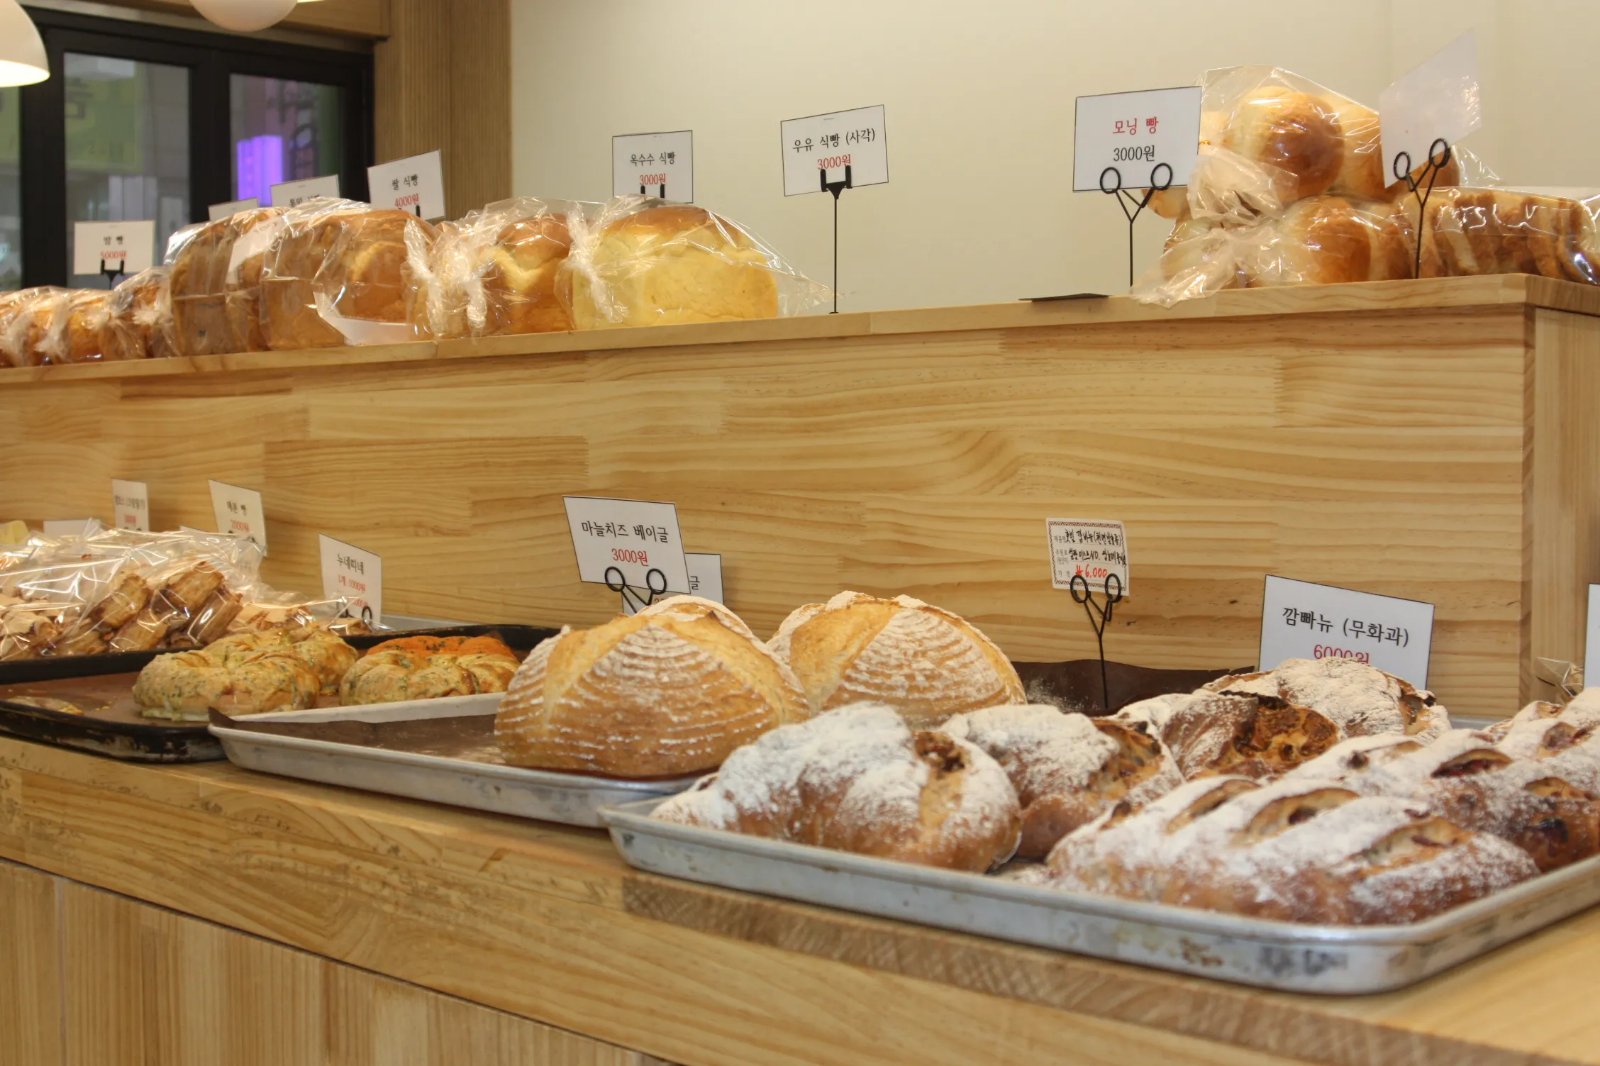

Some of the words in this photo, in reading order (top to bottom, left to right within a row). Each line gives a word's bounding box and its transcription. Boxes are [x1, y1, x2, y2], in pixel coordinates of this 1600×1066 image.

[1113, 117, 1137, 136] 모닝
[1145, 116, 1159, 135] 빵
[793, 138, 814, 153] 우유
[820, 133, 840, 149] 식빵
[845, 128, 876, 146] (사각)
[630, 153, 655, 167] 옥수수
[659, 151, 676, 166] 식빵
[817, 153, 851, 170] 3000원
[1113, 144, 1155, 162] 3000원
[403, 174, 419, 188] 식빵
[640, 173, 666, 186] 3000원
[581, 520, 629, 538] 마늘치즈
[633, 524, 669, 544] 베이글
[611, 548, 649, 567] 3000원
[1283, 607, 1334, 634] 깜빠뉴
[1343, 617, 1410, 648] (무화과)
[1313, 644, 1370, 665] 6000원
